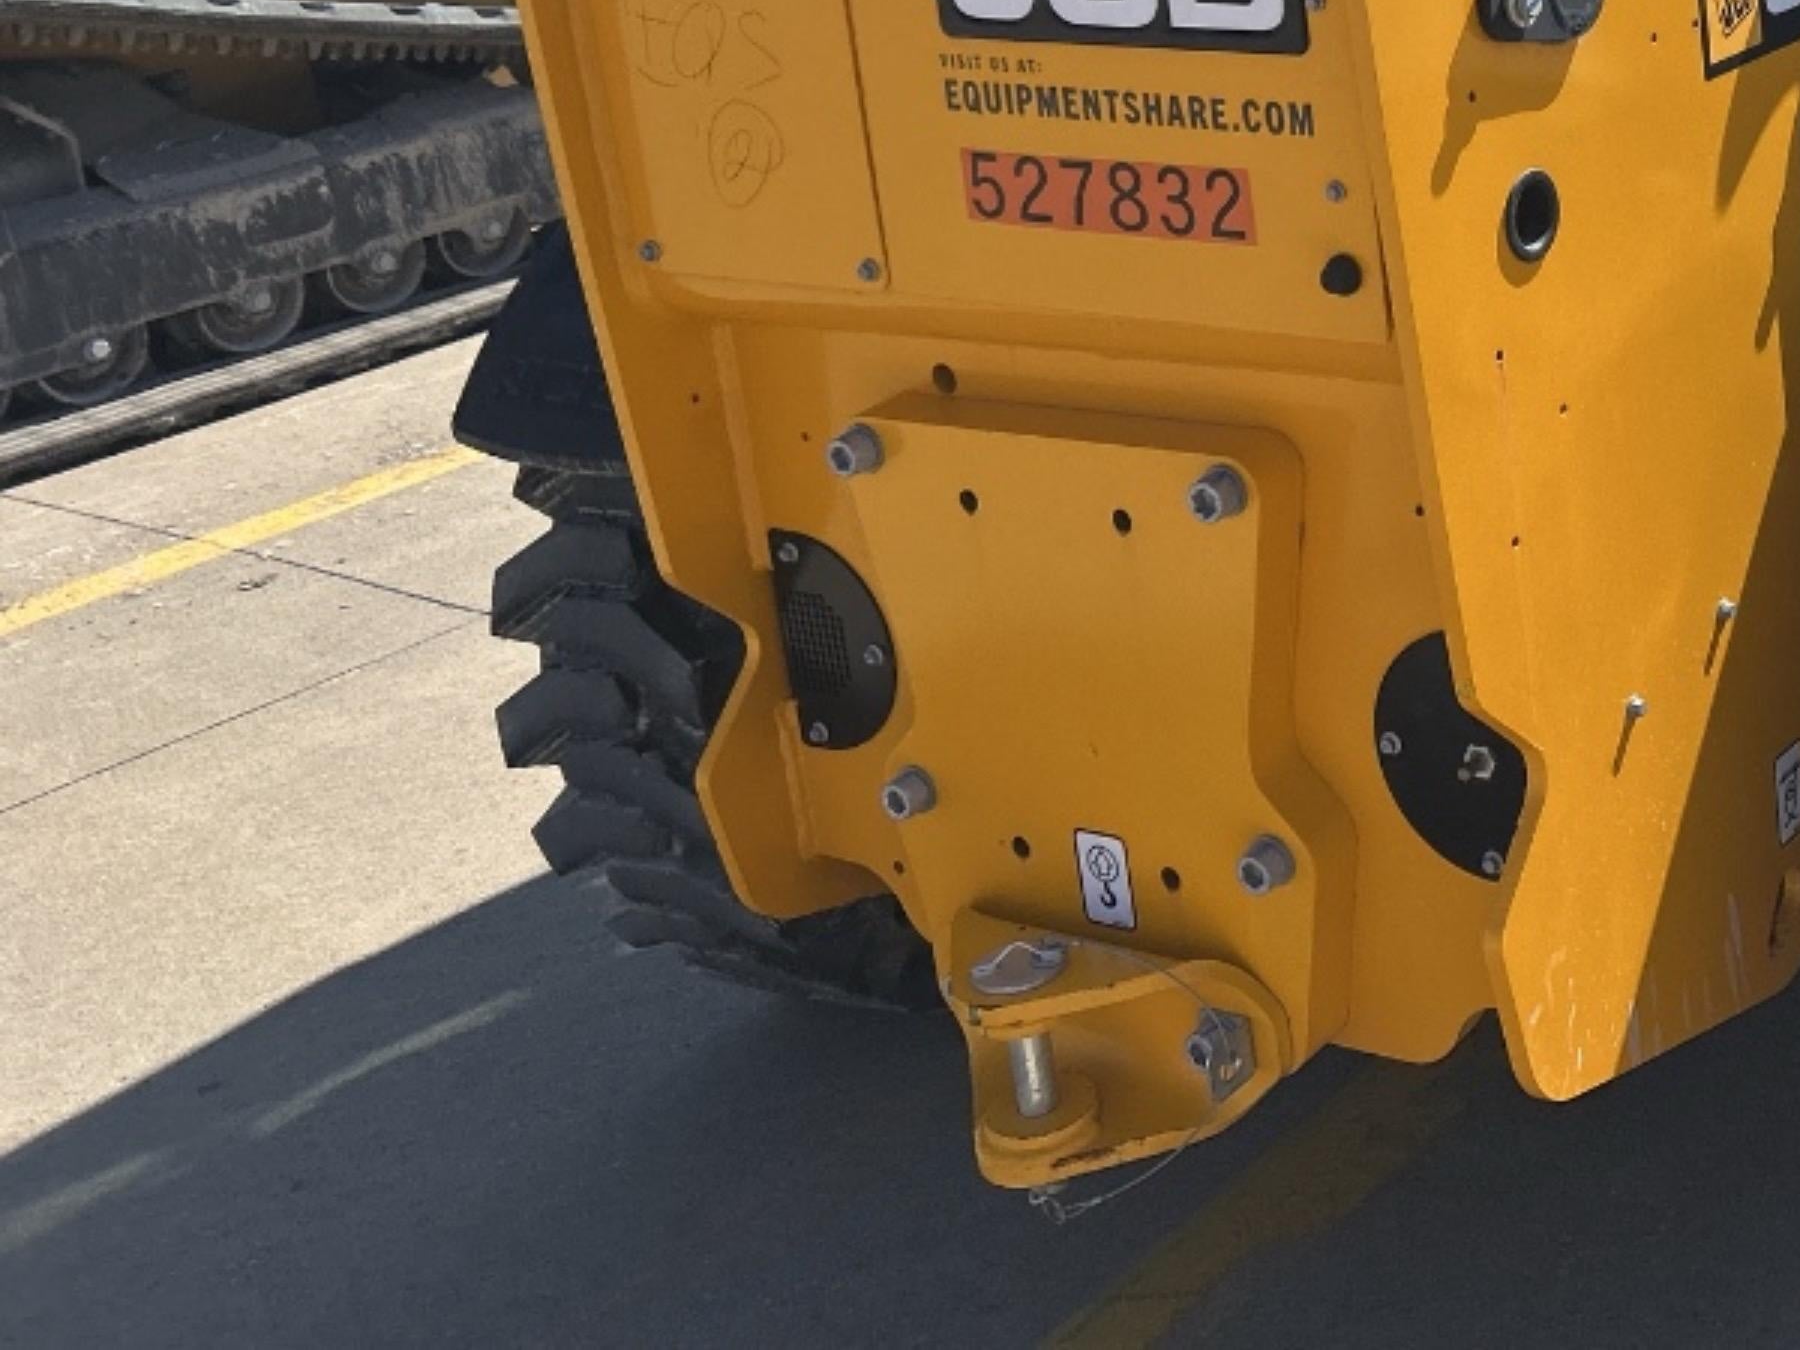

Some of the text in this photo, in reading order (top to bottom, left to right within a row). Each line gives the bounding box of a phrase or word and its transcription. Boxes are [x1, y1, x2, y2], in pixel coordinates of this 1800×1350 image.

[938, 53, 982, 70] VISIT
[989, 55, 1010, 74] US
[944, 78, 1315, 138] EQUIPMENTSHARE.COM
[970, 150, 1247, 241] 527832
